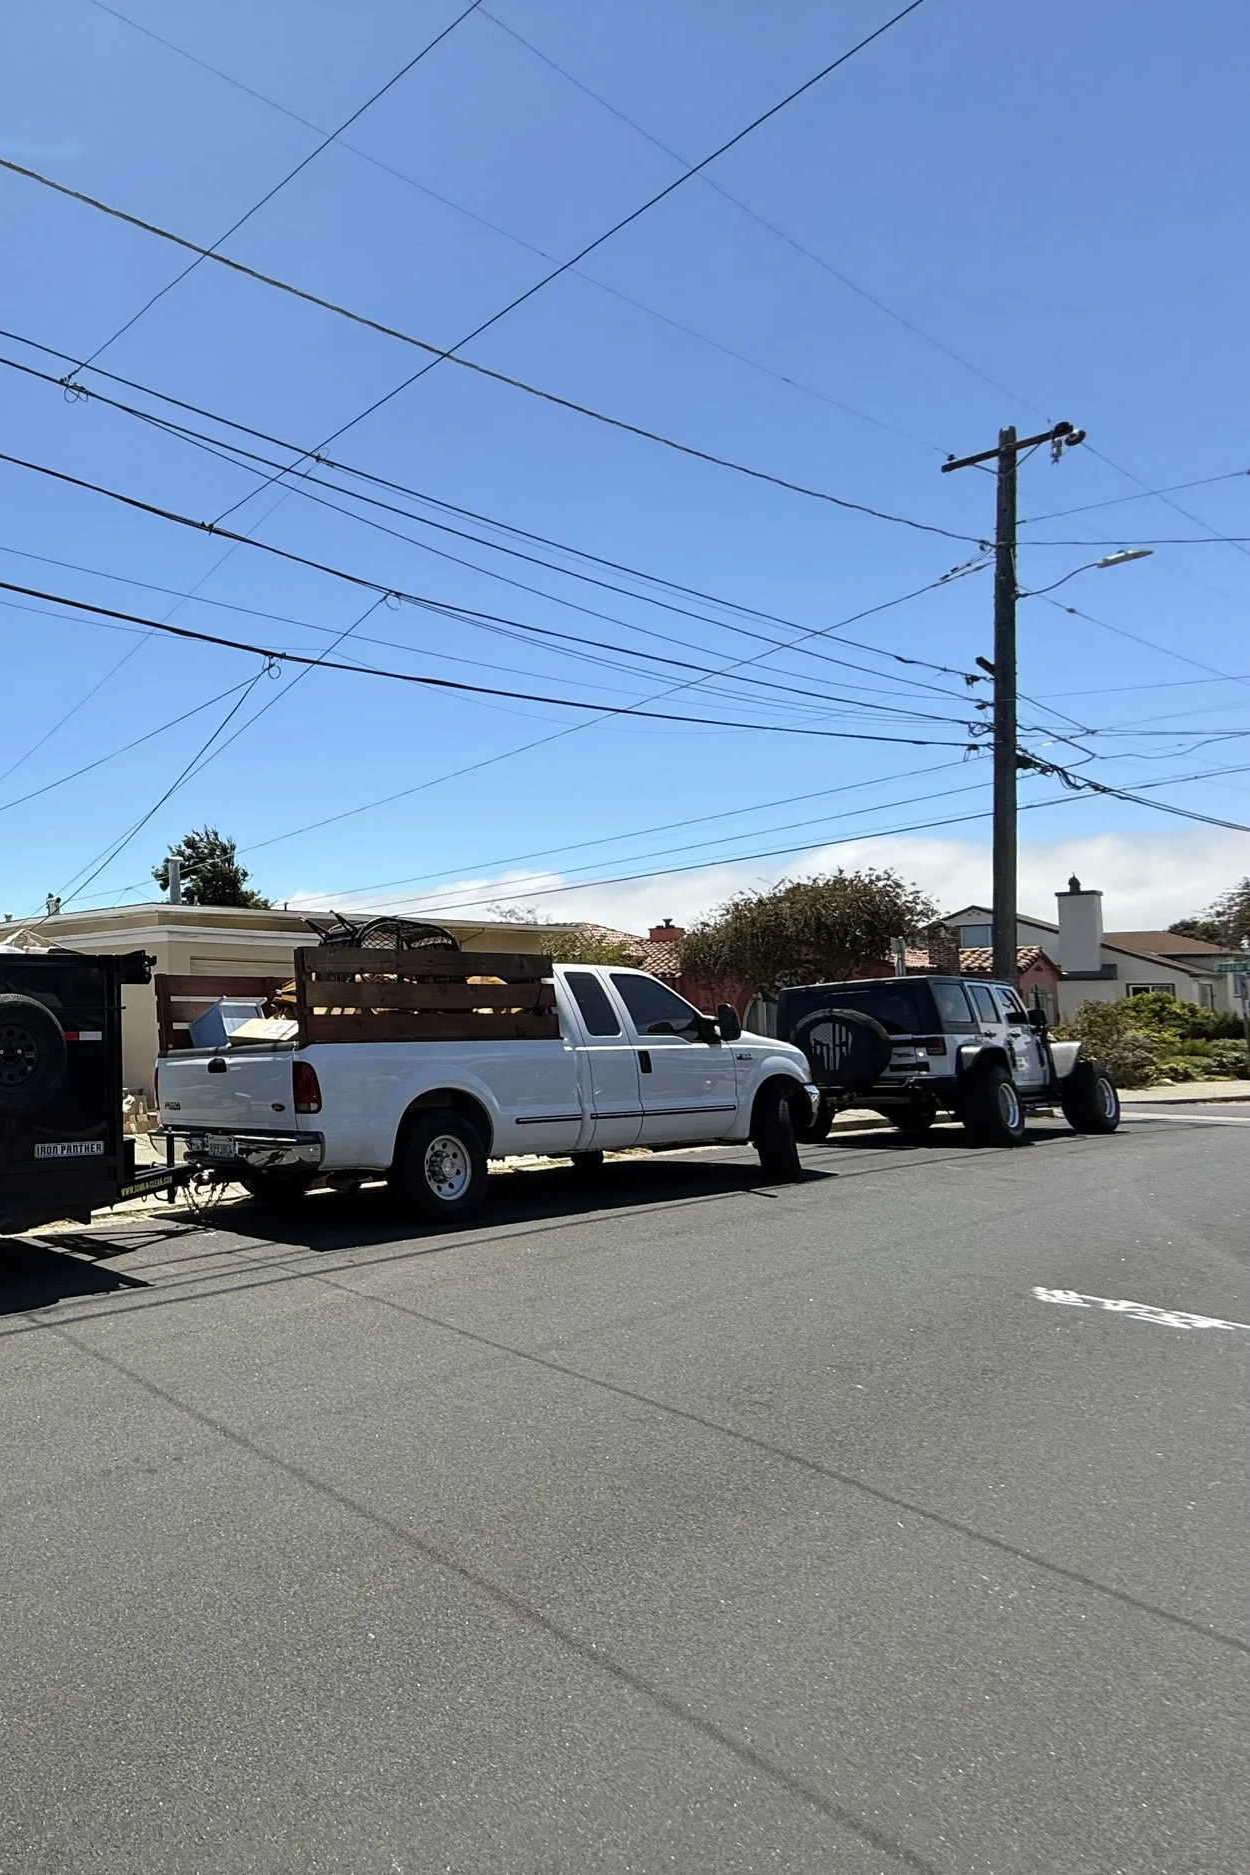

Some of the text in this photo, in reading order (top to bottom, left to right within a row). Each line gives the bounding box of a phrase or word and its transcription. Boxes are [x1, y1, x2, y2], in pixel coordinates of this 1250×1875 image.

[36, 1143, 103, 1156] IRON PANTHER
[121, 1175, 173, 1197] WWW.JUNK-N-CLEAN.COM
